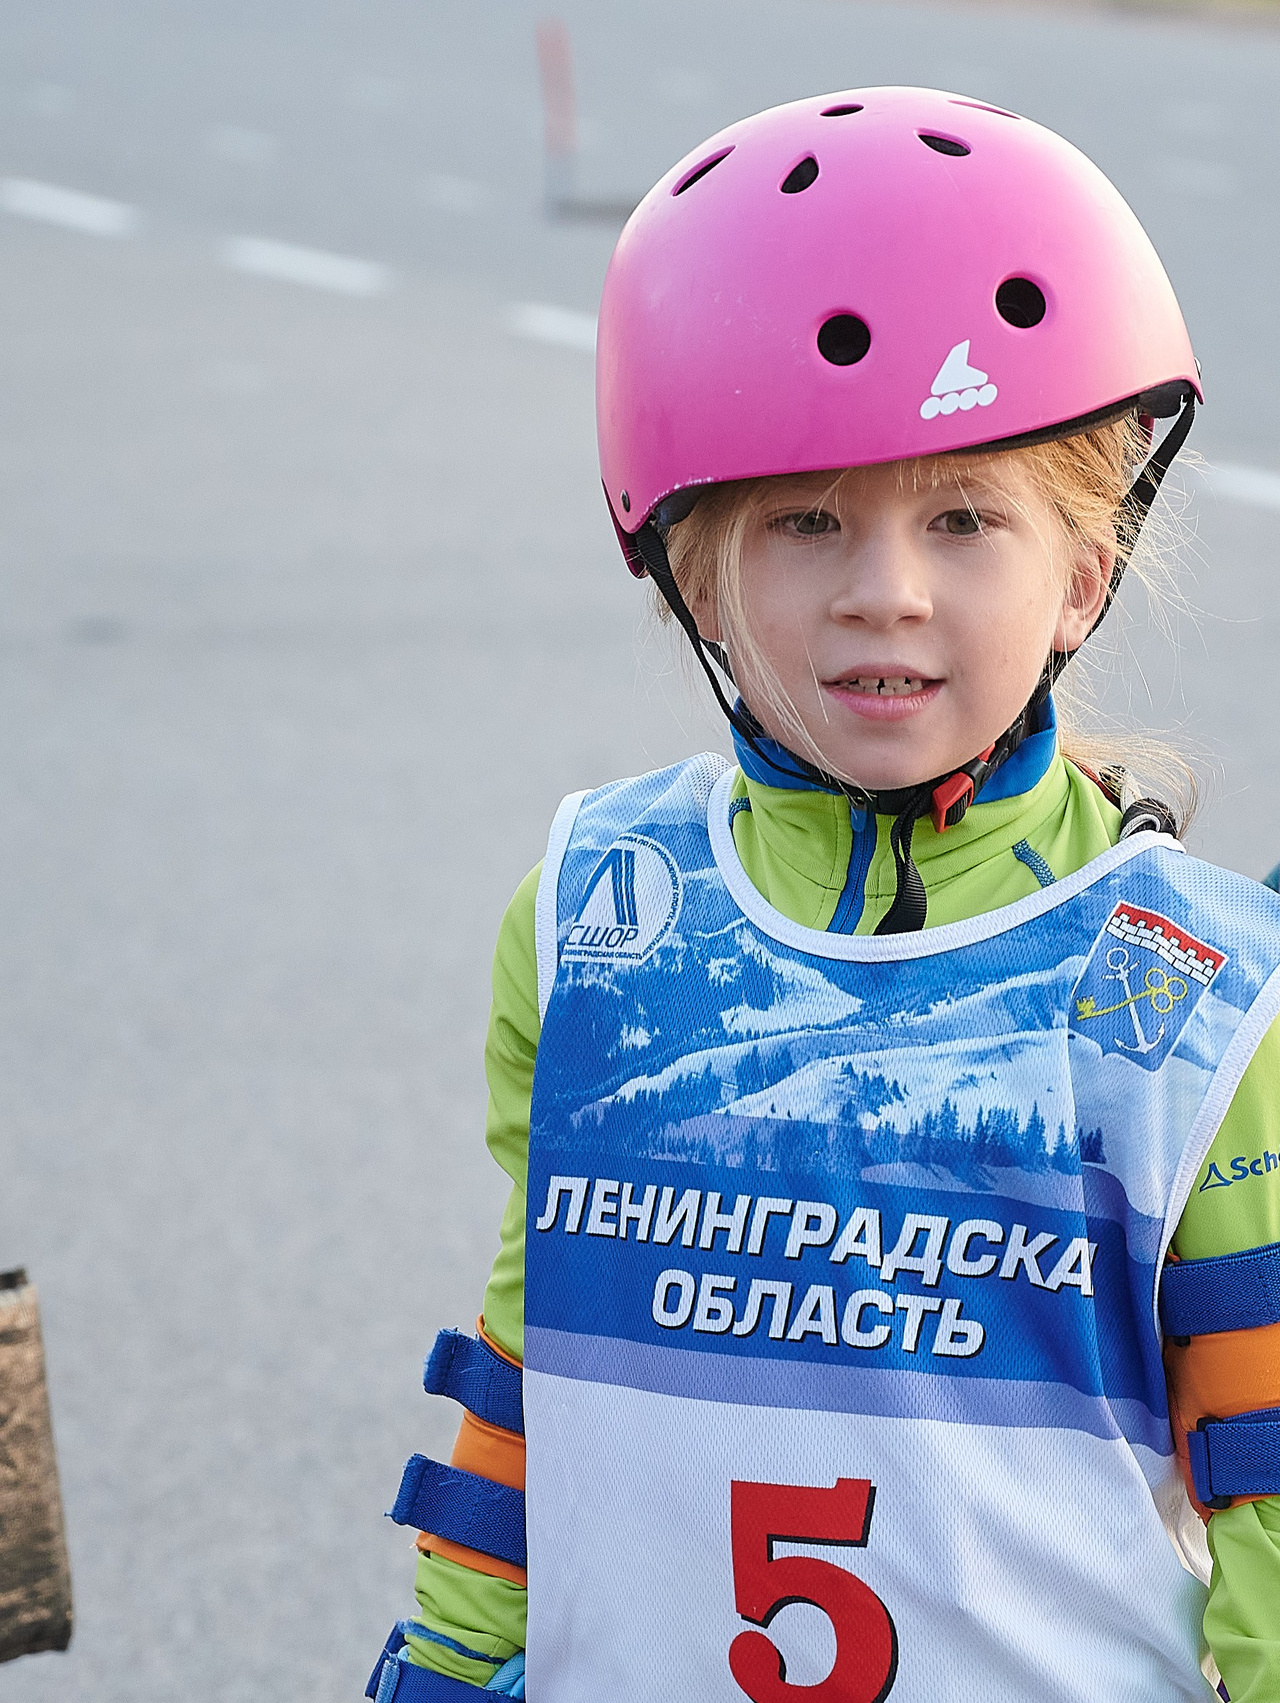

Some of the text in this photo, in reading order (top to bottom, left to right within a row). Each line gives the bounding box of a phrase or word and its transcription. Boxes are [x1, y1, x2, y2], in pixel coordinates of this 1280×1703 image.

[567, 925, 639, 948] СШОР
[535, 1175, 1099, 1298] ЛЕНИНГРАДСКА
[652, 1268, 987, 1358] ОБЛАСТЬ
[728, 1477, 898, 1703] 5
